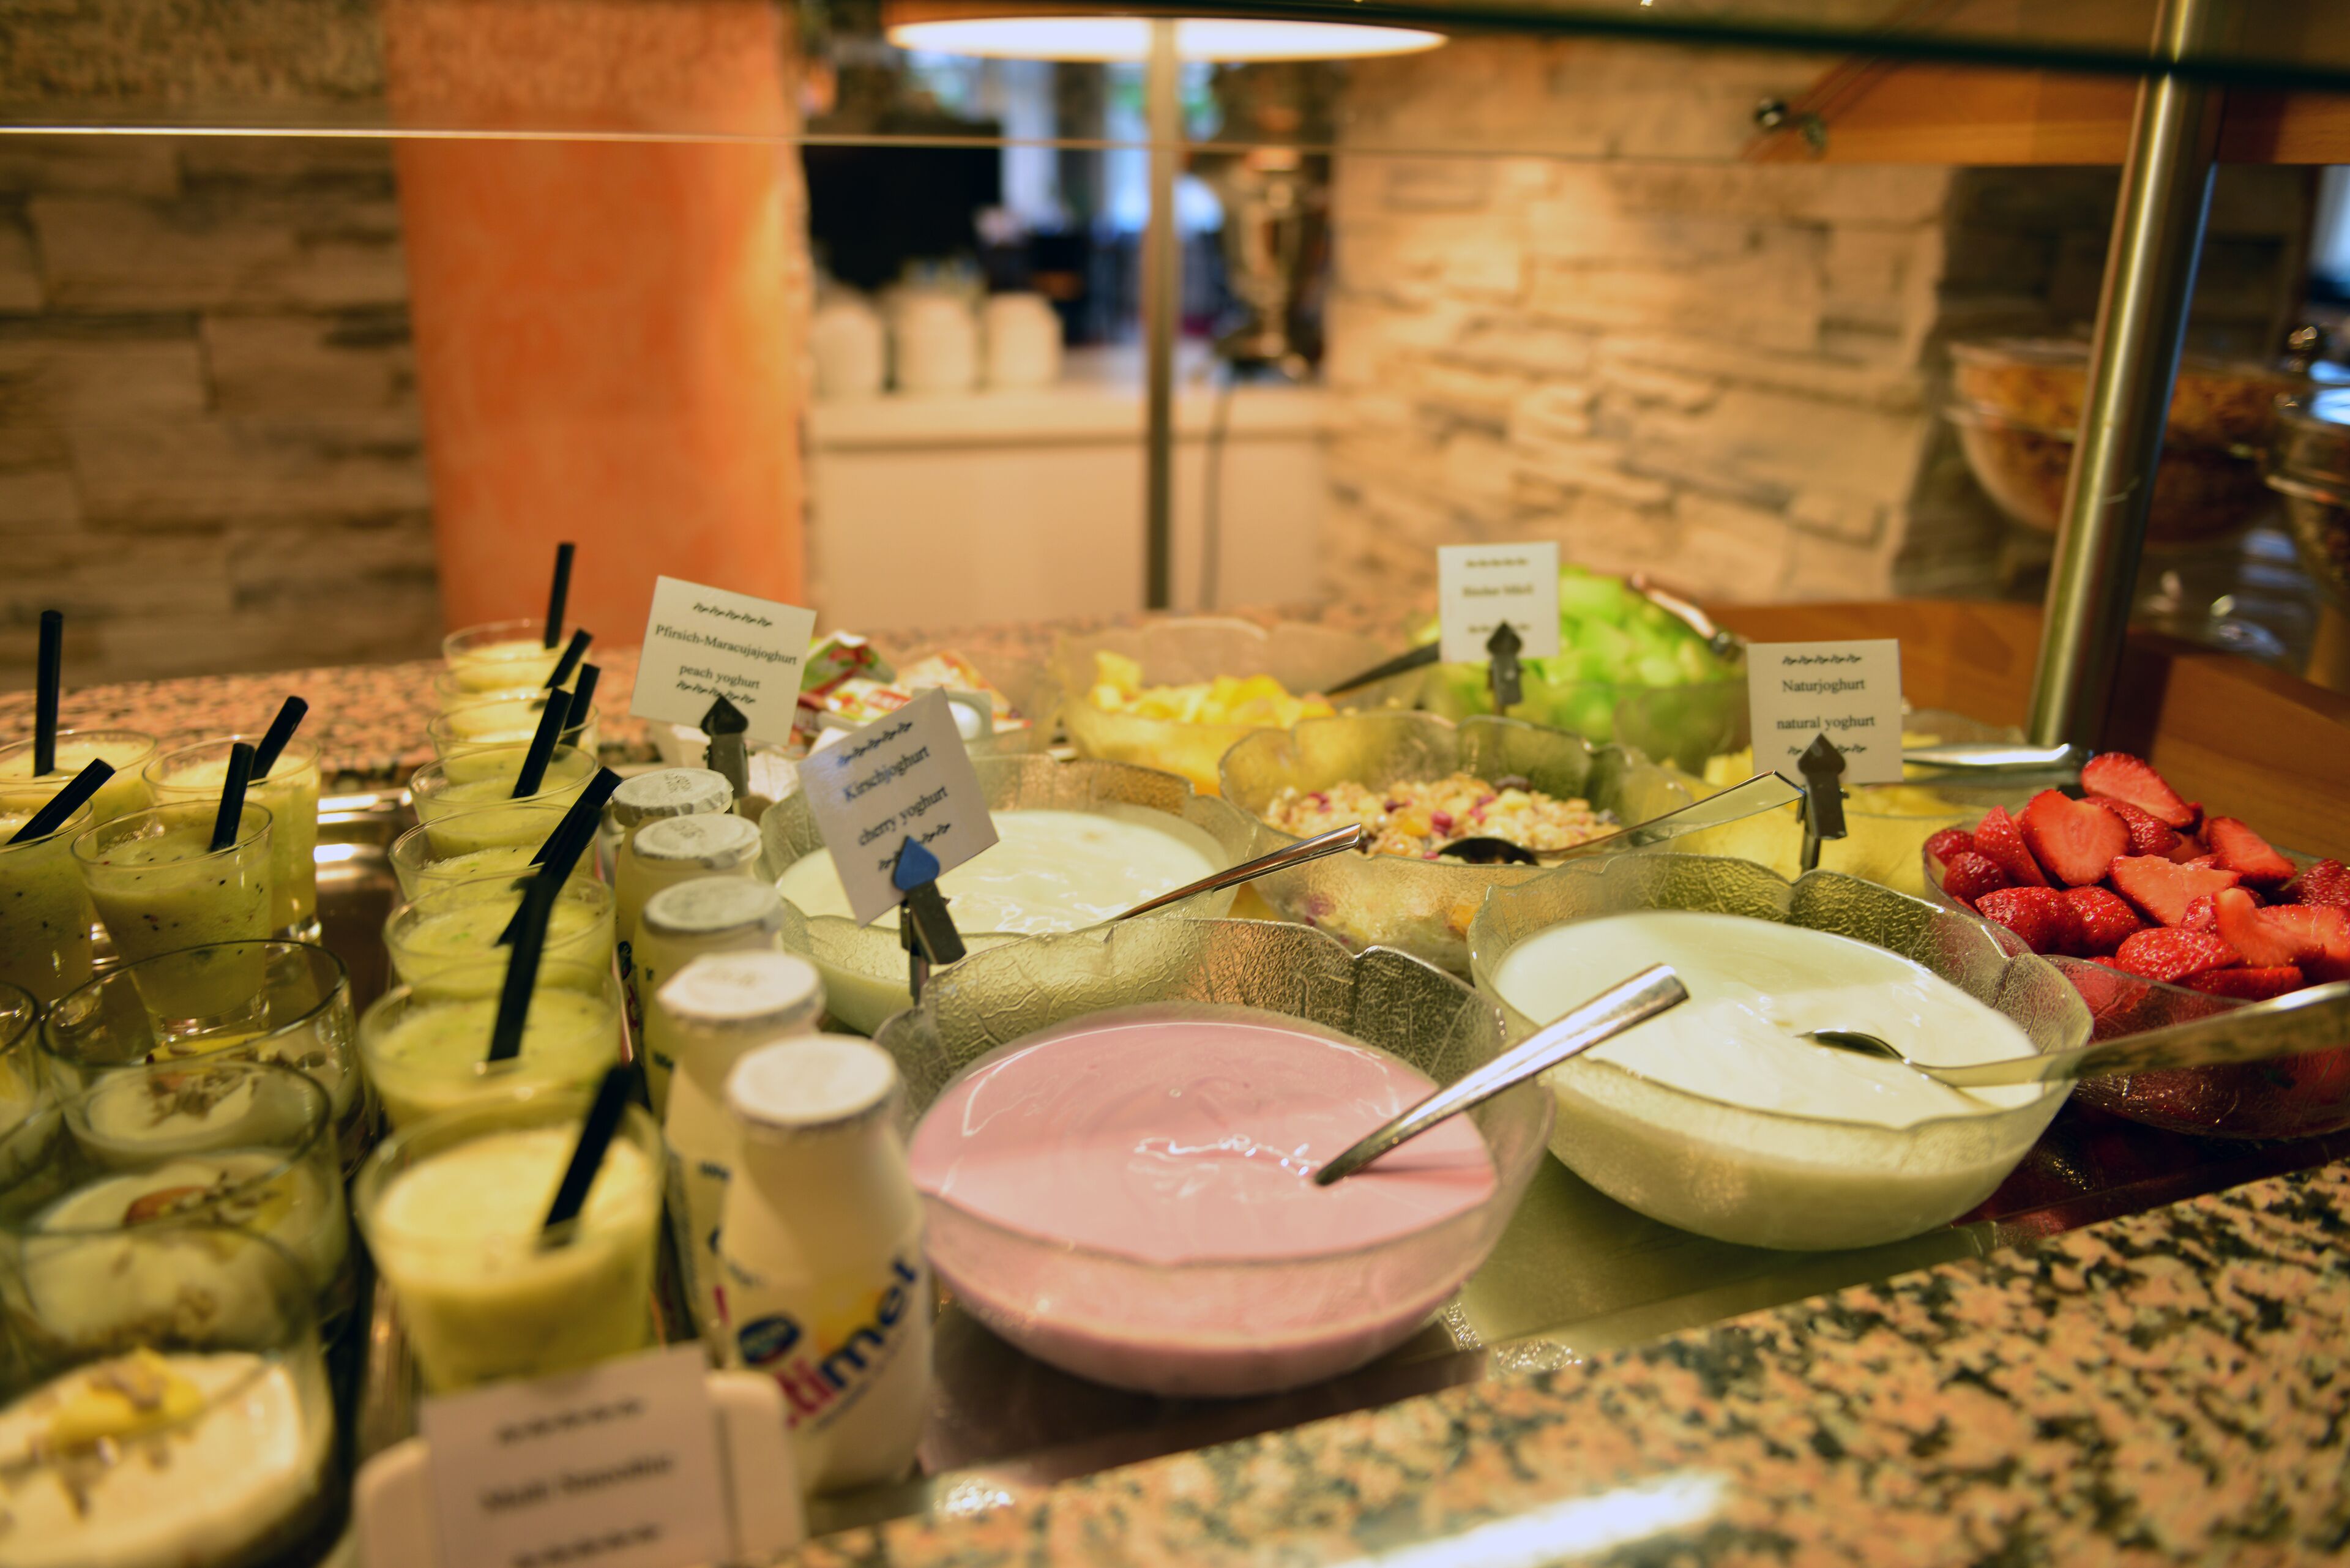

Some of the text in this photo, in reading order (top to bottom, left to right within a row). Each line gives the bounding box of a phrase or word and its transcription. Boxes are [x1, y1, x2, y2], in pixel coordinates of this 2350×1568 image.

[655, 624, 797, 665] Pfirsich-Maracujajoghurt
[679, 665, 760, 689] peach yoghurt
[1781, 678, 1865, 694] Naturjoghurt
[1776, 714, 1876, 731] natural yoghurt
[843, 746, 930, 802] Kirschjoghurt
[859, 786, 949, 846] cherry yoghurt
